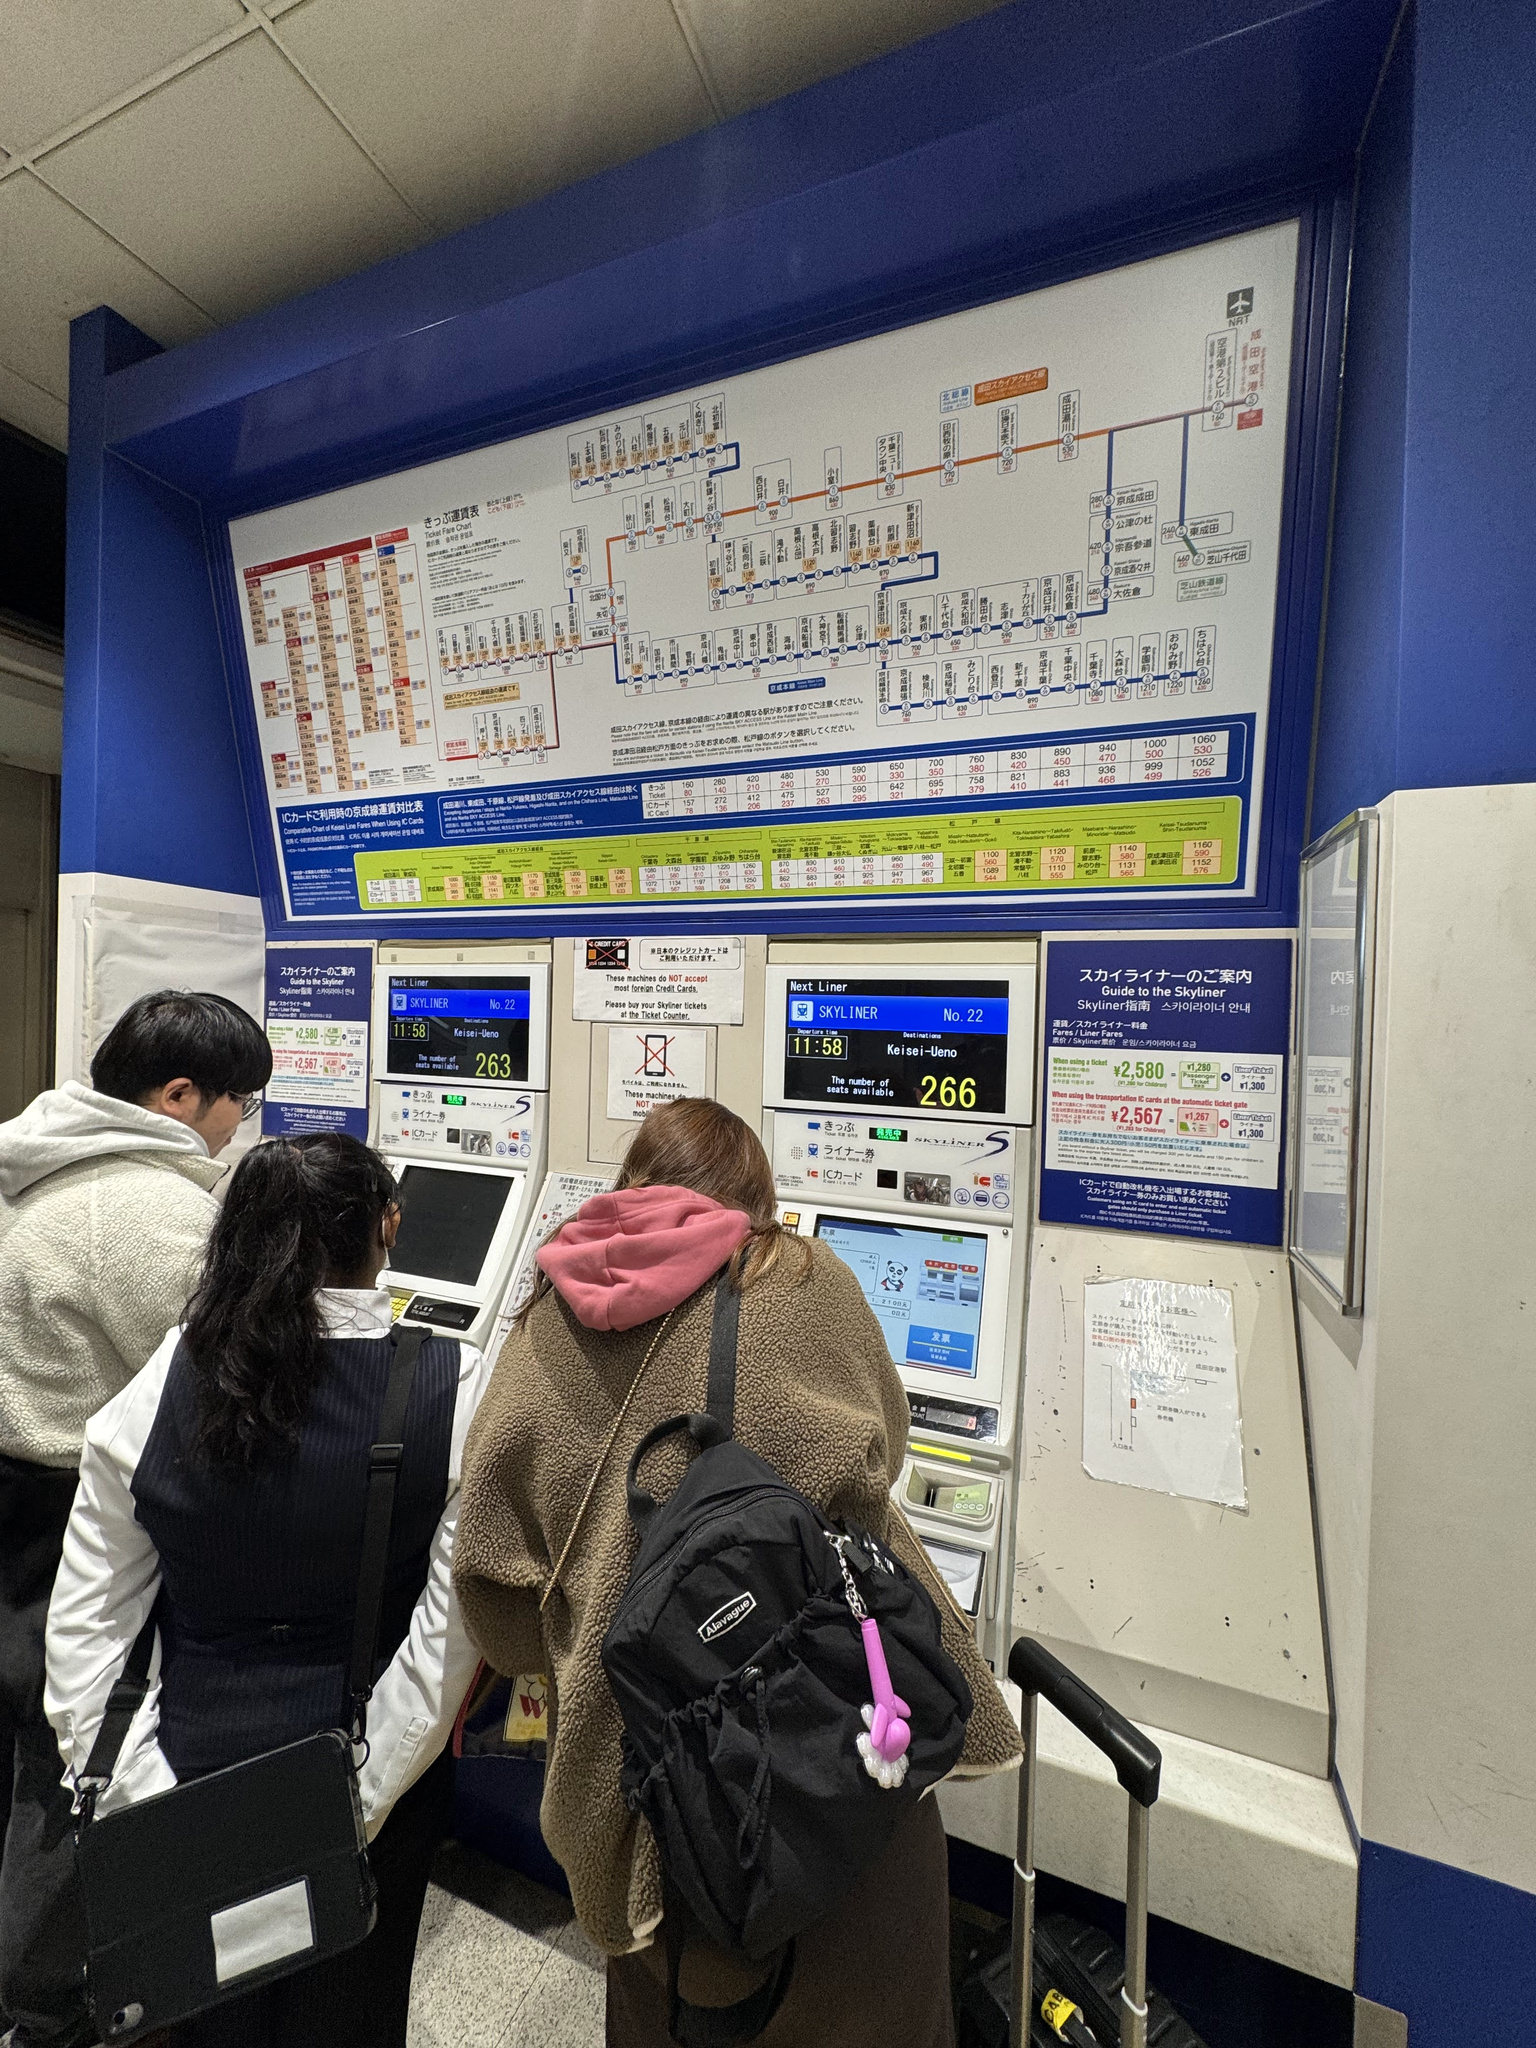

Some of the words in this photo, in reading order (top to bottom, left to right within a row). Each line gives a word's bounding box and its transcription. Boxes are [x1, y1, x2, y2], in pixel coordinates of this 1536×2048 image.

[1229, 315, 1249, 327] NRT
[424, 505, 480, 528] きっぷ運賃表
[425, 529, 441, 539] Ticket
[442, 526, 455, 535] Fare
[456, 523, 472, 532] Chart
[1054, 748, 1070, 756] 890
[1099, 744, 1116, 752] 940
[1144, 739, 1167, 748] 1000
[1192, 735, 1216, 744] 1060
[1099, 754, 1116, 762] 470
[1145, 750, 1163, 758] 500
[1194, 745, 1212, 754] 530
[1099, 766, 1115, 774] 936
[1145, 762, 1163, 770] 999
[1191, 758, 1215, 767] 1052
[280, 966, 355, 976] スカイライナーのご案内
[1080, 969, 1252, 984] スカイライナーのご案内
[322, 978, 344, 986] Skyliner
[392, 978, 406, 986] Next
[791, 981, 812, 992] Next
[819, 982, 847, 993] Liner
[1102, 986, 1135, 996] Guide
[1138, 986, 1149, 996] to
[1153, 986, 1171, 996] the
[1175, 987, 1226, 999] Skyliner
[410, 998, 448, 1008] SKYLINER
[490, 999, 515, 1010] No.22
[628, 1001, 639, 1009] buy
[641, 1002, 654, 1010] your
[657, 1002, 682, 1010] Skyliner
[685, 1002, 707, 1010] tickets
[1077, 999, 1151, 1012] Skyliner指南
[1161, 1002, 1224, 1012] 스카이라이너
[1228, 1003, 1251, 1013] 안내
[819, 1006, 878, 1020] SKYLINER
[944, 1008, 983, 1023] No.22
[394, 1024, 425, 1038] 11:58
[454, 1028, 498, 1038] Keisei-Ueno
[794, 1037, 842, 1056] 11:58
[887, 1044, 957, 1058] Keisei-Ueno
[475, 1052, 511, 1078] 263
[1070, 1058, 1085, 1066] using
[1114, 1061, 1164, 1080] ¥2,580
[832, 1075, 845, 1085] The
[849, 1077, 875, 1086] number
[880, 1078, 889, 1087] of
[1240, 1082, 1265, 1090] ¥1,300
[413, 1091, 432, 1099] きっぷ
[625, 1090, 643, 1098] These
[646, 1092, 675, 1100] machines
[827, 1086, 849, 1094] seats
[853, 1087, 894, 1097] available
[920, 1075, 977, 1108] 266
[636, 1100, 649, 1108] NOT
[1052, 1091, 1067, 1099] When
[1069, 1093, 1083, 1101] using
[1096, 1094, 1136, 1103] transportation
[1182, 1098, 1212, 1106] automatic
[412, 1110, 445, 1120] ライナー券
[1111, 1106, 1162, 1126] ¥2,567
[412, 1129, 438, 1137] ICカード
[824, 1120, 855, 1133] きっぷ
[1239, 1130, 1263, 1138] ¥1,300
[824, 1144, 875, 1159] ライナー券
[823, 1169, 863, 1182] ICカード
